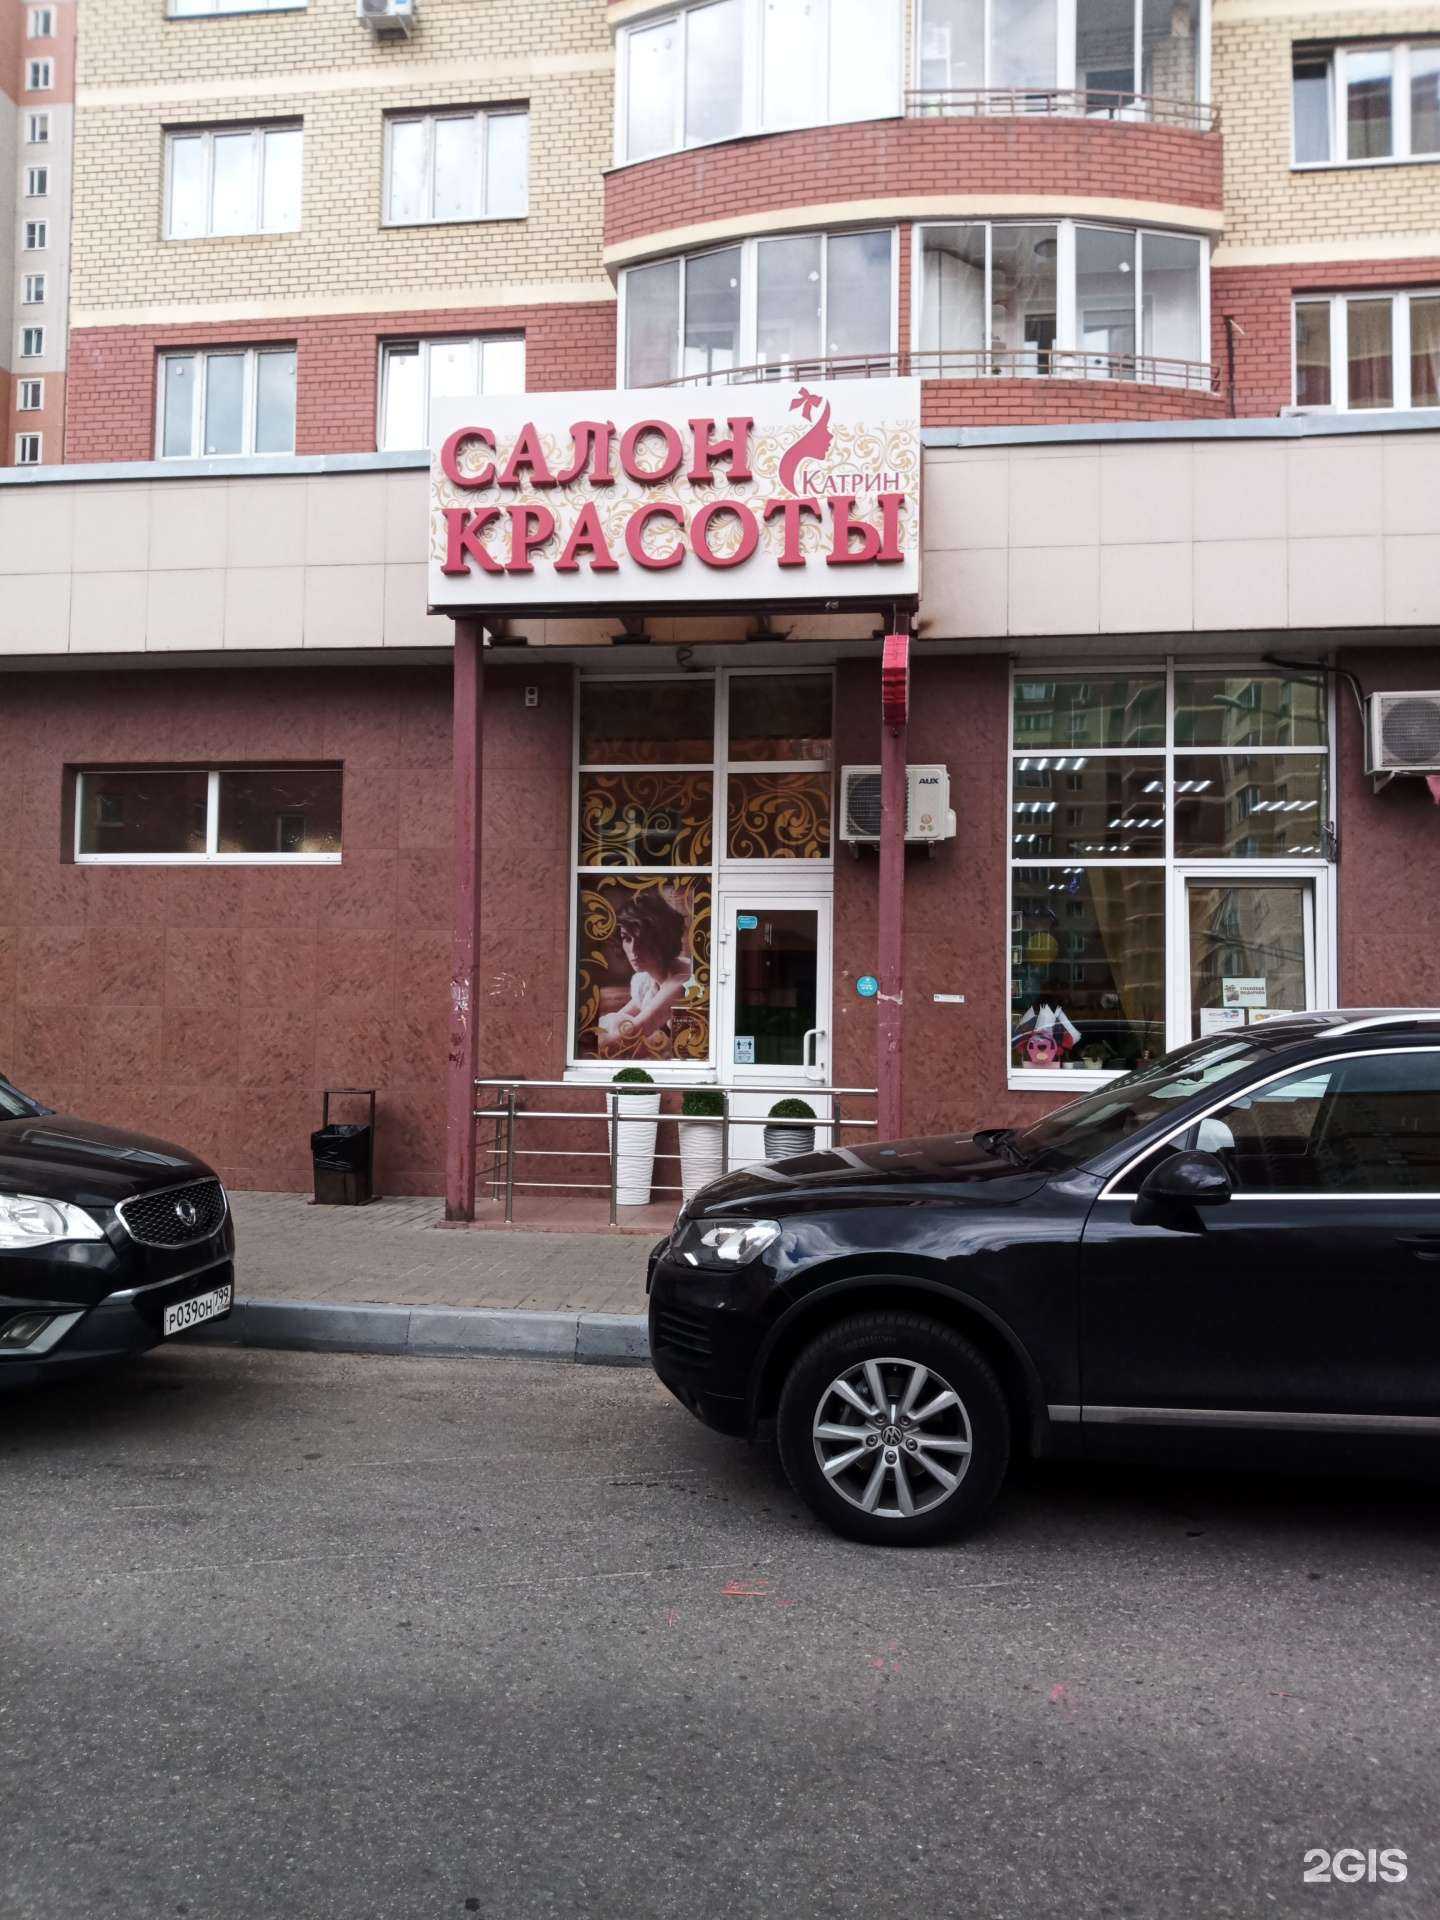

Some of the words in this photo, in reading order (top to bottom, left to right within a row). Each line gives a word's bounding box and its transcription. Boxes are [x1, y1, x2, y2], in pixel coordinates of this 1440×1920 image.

[441, 416, 754, 488] САЛОН
[440, 493, 906, 576] КРАСОТЫ
[918, 777, 939, 785] AUX
